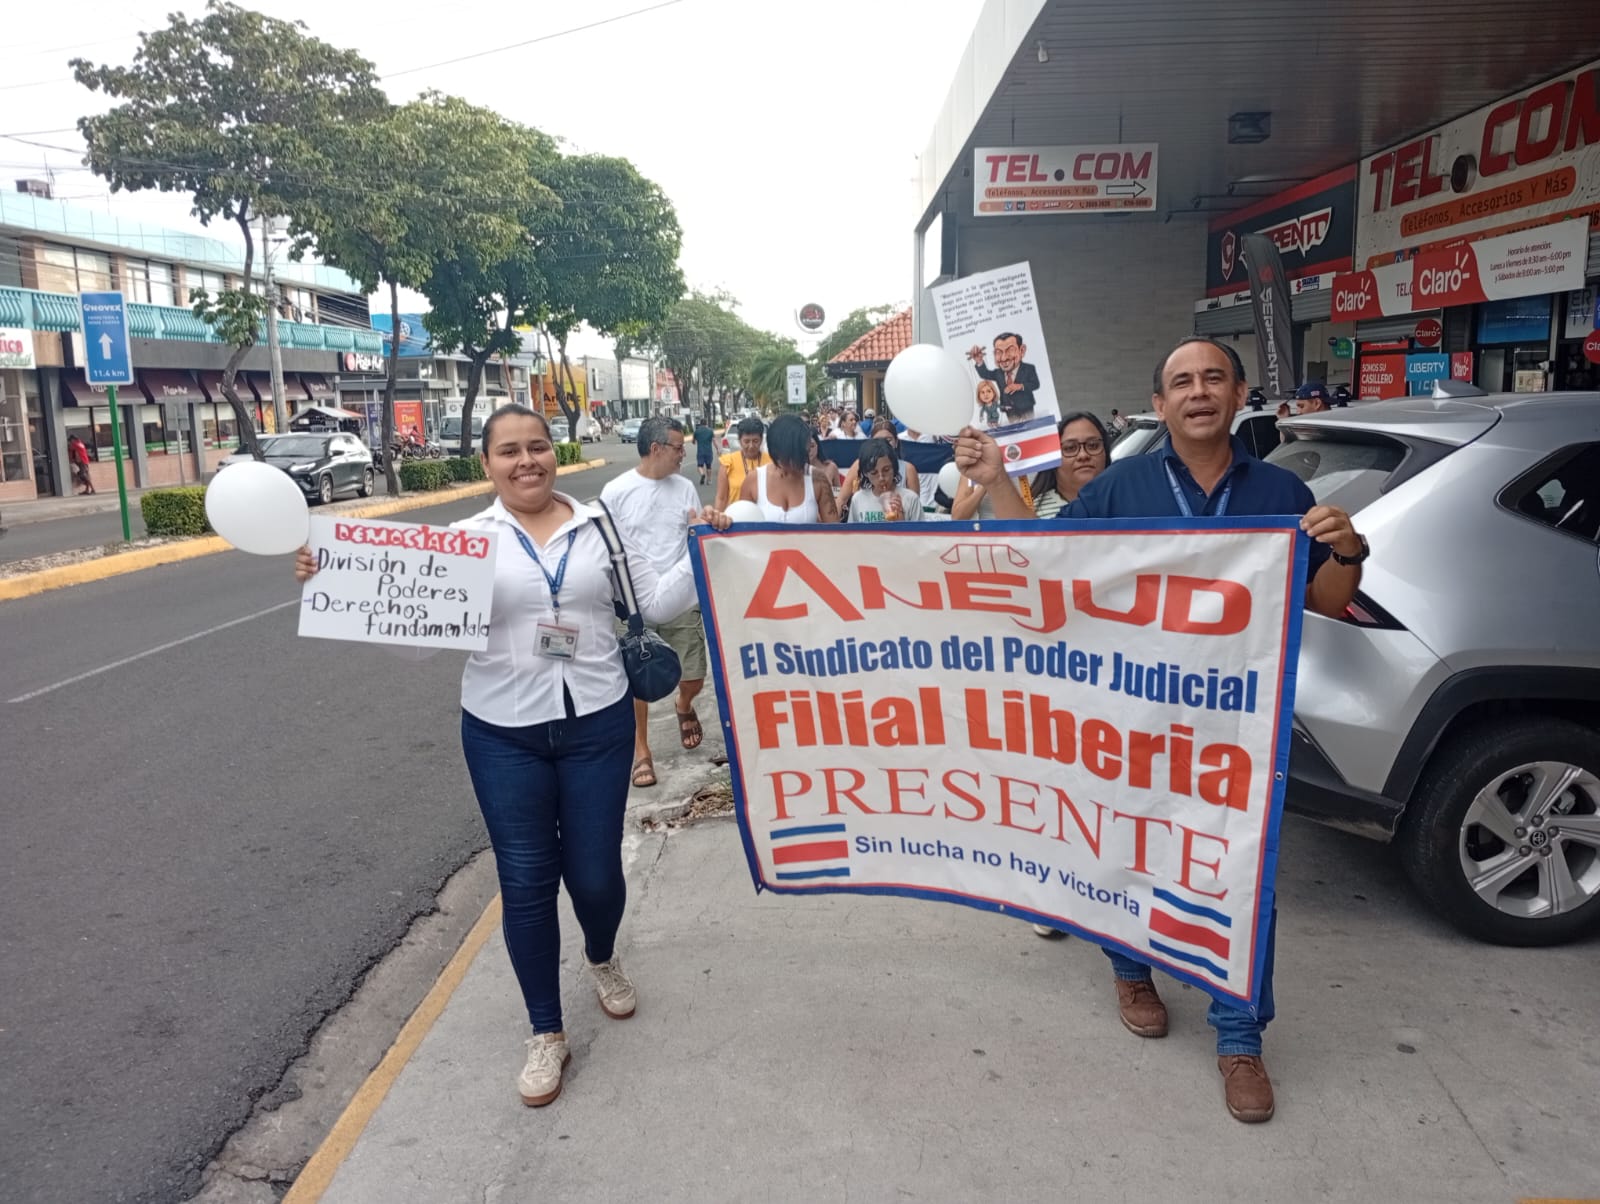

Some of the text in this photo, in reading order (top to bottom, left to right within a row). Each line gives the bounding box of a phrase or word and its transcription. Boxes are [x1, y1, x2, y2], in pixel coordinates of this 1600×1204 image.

[1460, 187, 1522, 217] Accesorios
[1530, 183, 1537, 194] Y
[1545, 176, 1569, 194] Más
[1419, 262, 1464, 296] Claro
[1336, 287, 1367, 314] Claro
[1362, 374, 1394, 384] CASILLERO
[1409, 362, 1444, 373] LIBERTY
[317, 548, 448, 577] División de
[378, 573, 468, 602] Poderes
[740, 635, 1259, 713] El Sindicato del Poder Judicial
[752, 687, 1252, 812] Filial Liberia
[765, 767, 1230, 901] PRESENTE
[854, 835, 1142, 917] Sin lucha no hay victoria
